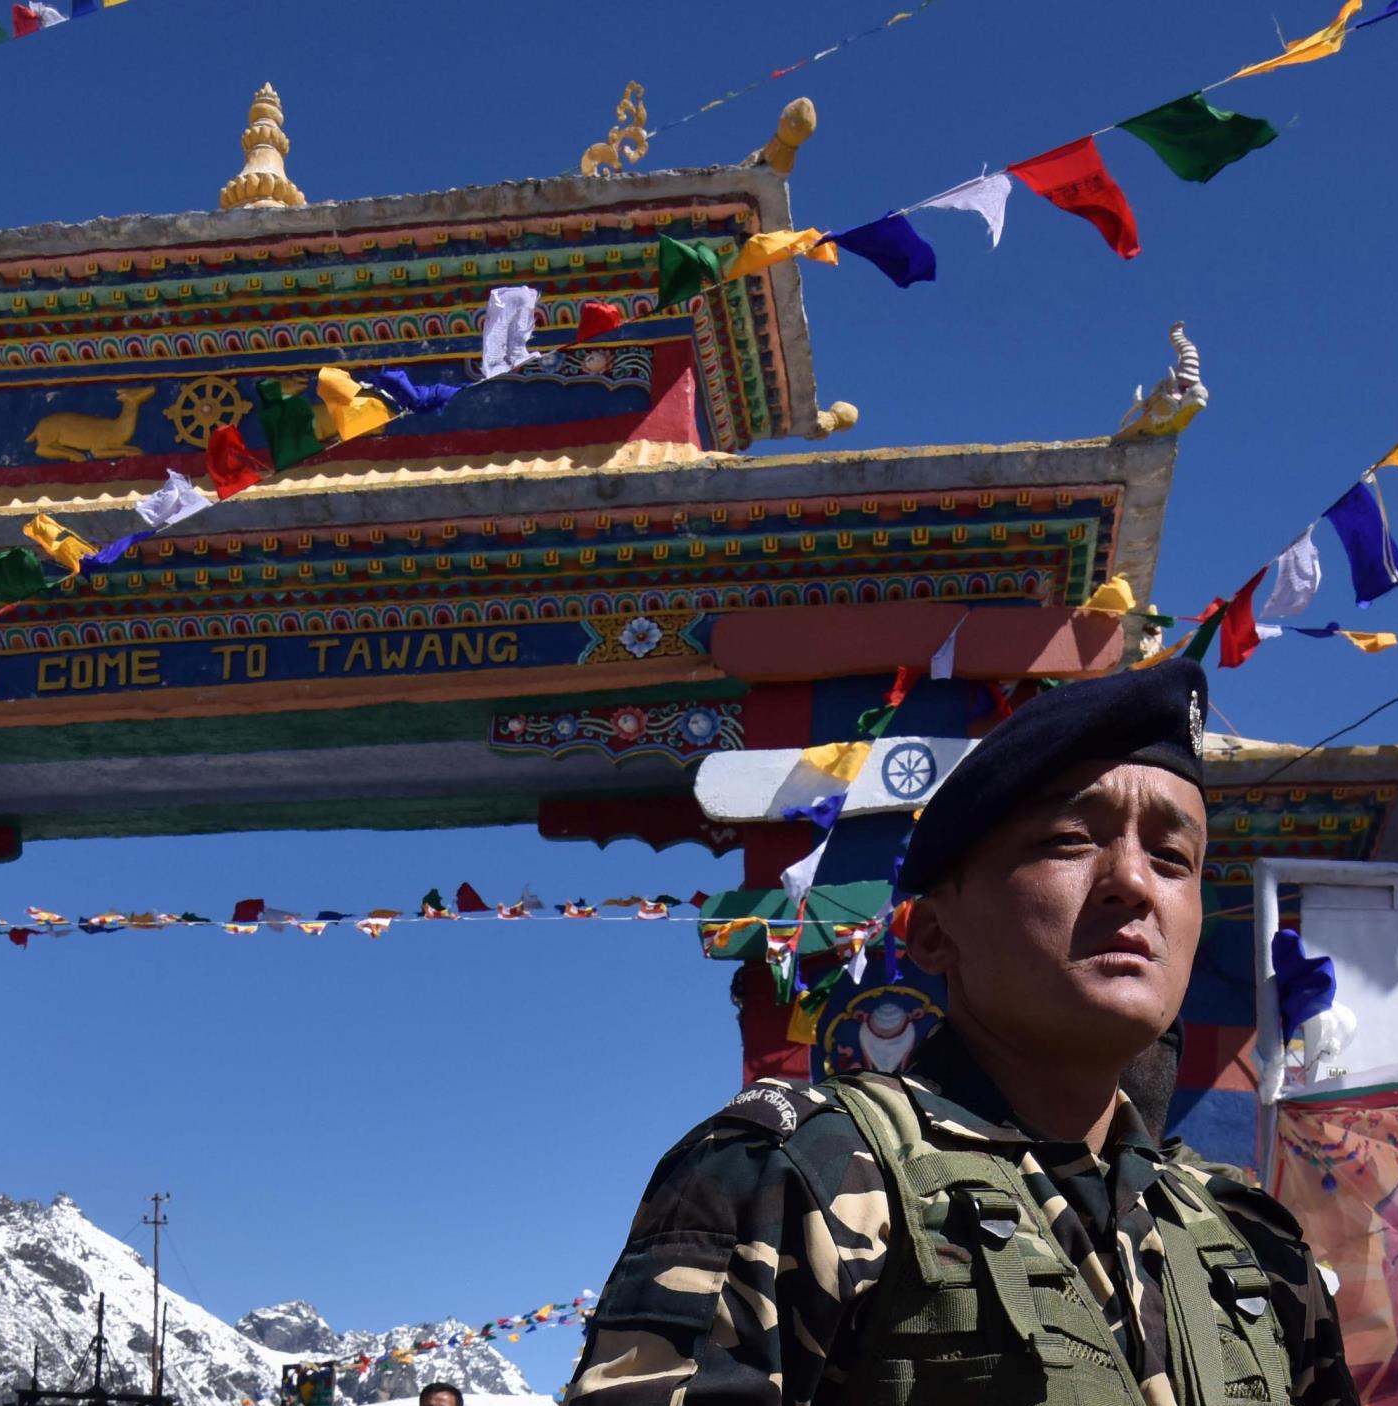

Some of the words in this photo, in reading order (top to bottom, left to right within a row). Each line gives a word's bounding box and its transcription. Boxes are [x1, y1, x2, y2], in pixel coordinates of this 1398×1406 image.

[37, 650, 161, 692] COME
[211, 643, 267, 680] TO
[308, 630, 518, 673] TAWANG
